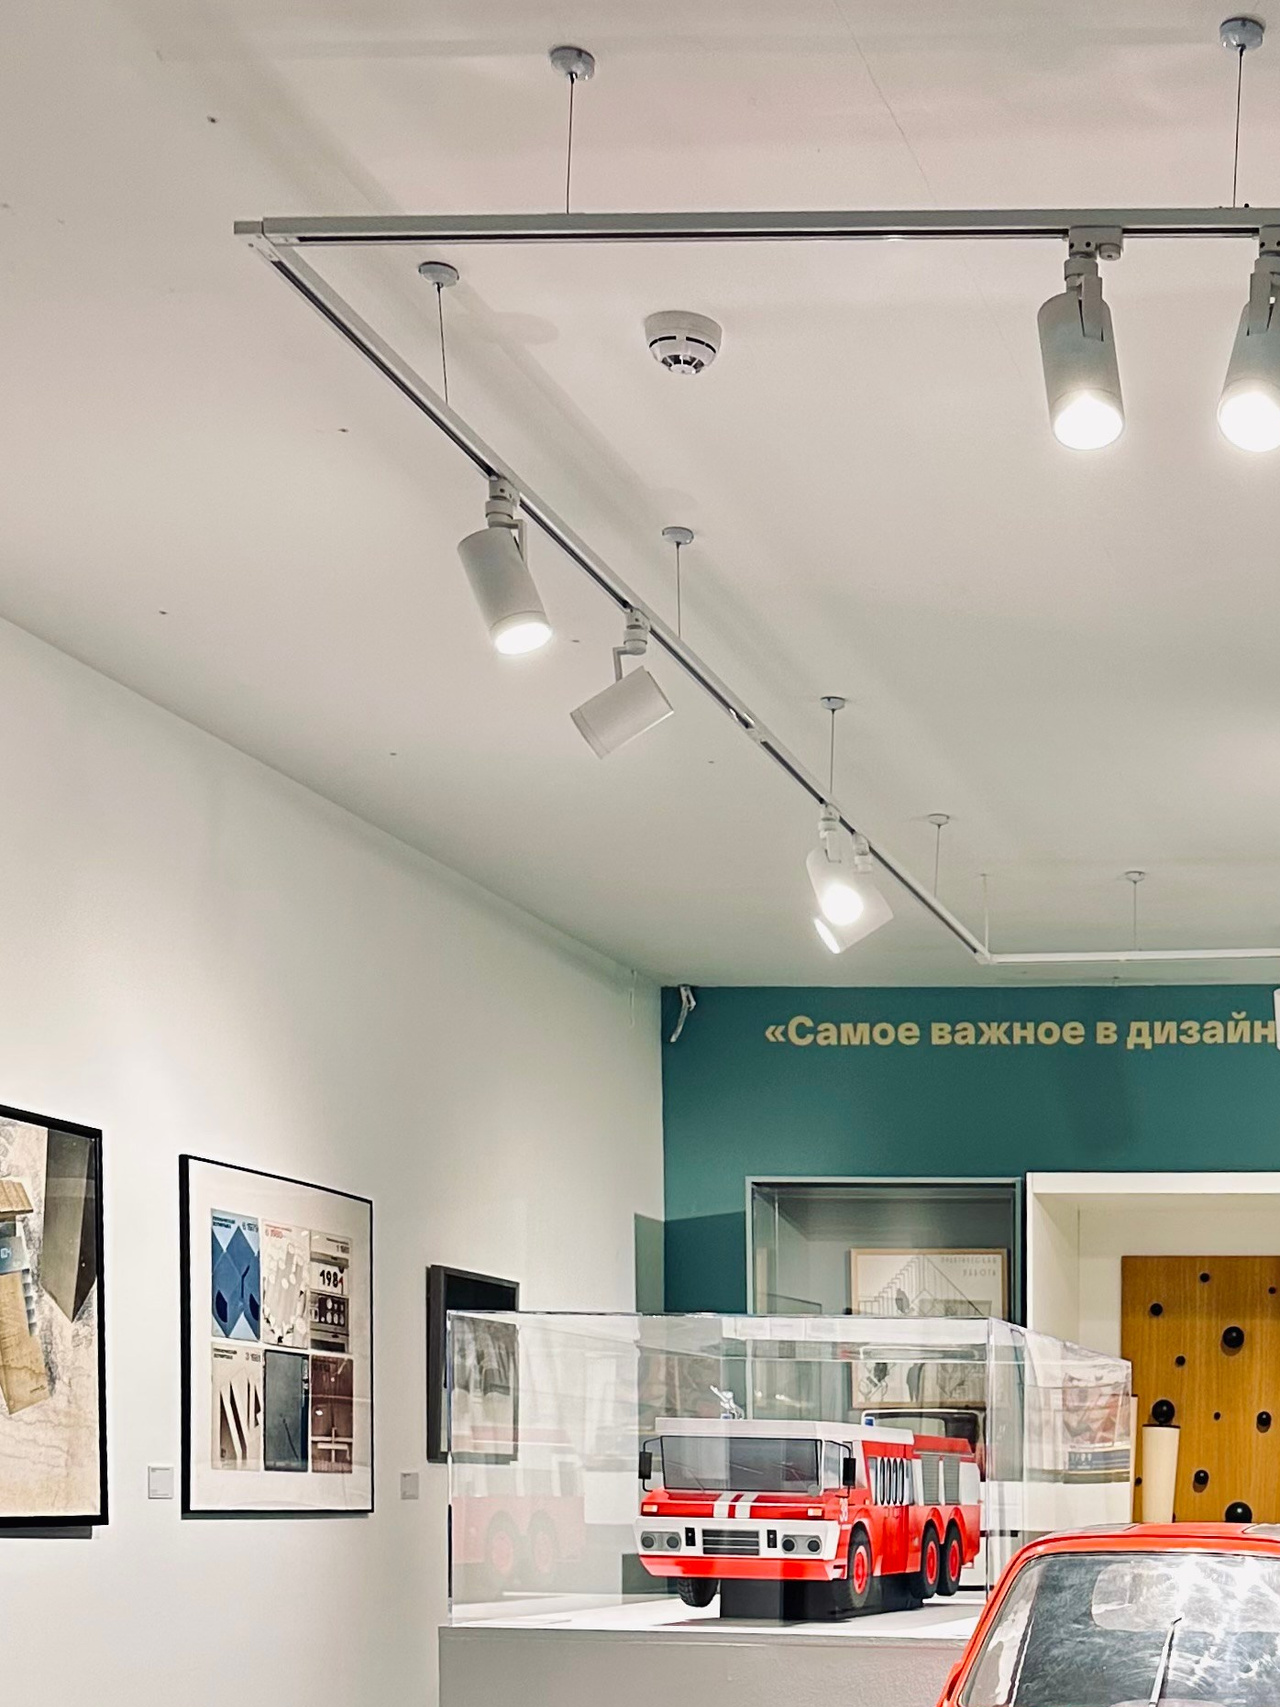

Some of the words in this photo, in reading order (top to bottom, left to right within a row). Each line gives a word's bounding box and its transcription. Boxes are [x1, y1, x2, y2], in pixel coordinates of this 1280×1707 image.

[764, 1014, 920, 1047] «Самое
[930, 1020, 1085, 1047] важное
[1095, 1021, 1118, 1046] в
[1126, 1010, 1276, 1050] дизайн
